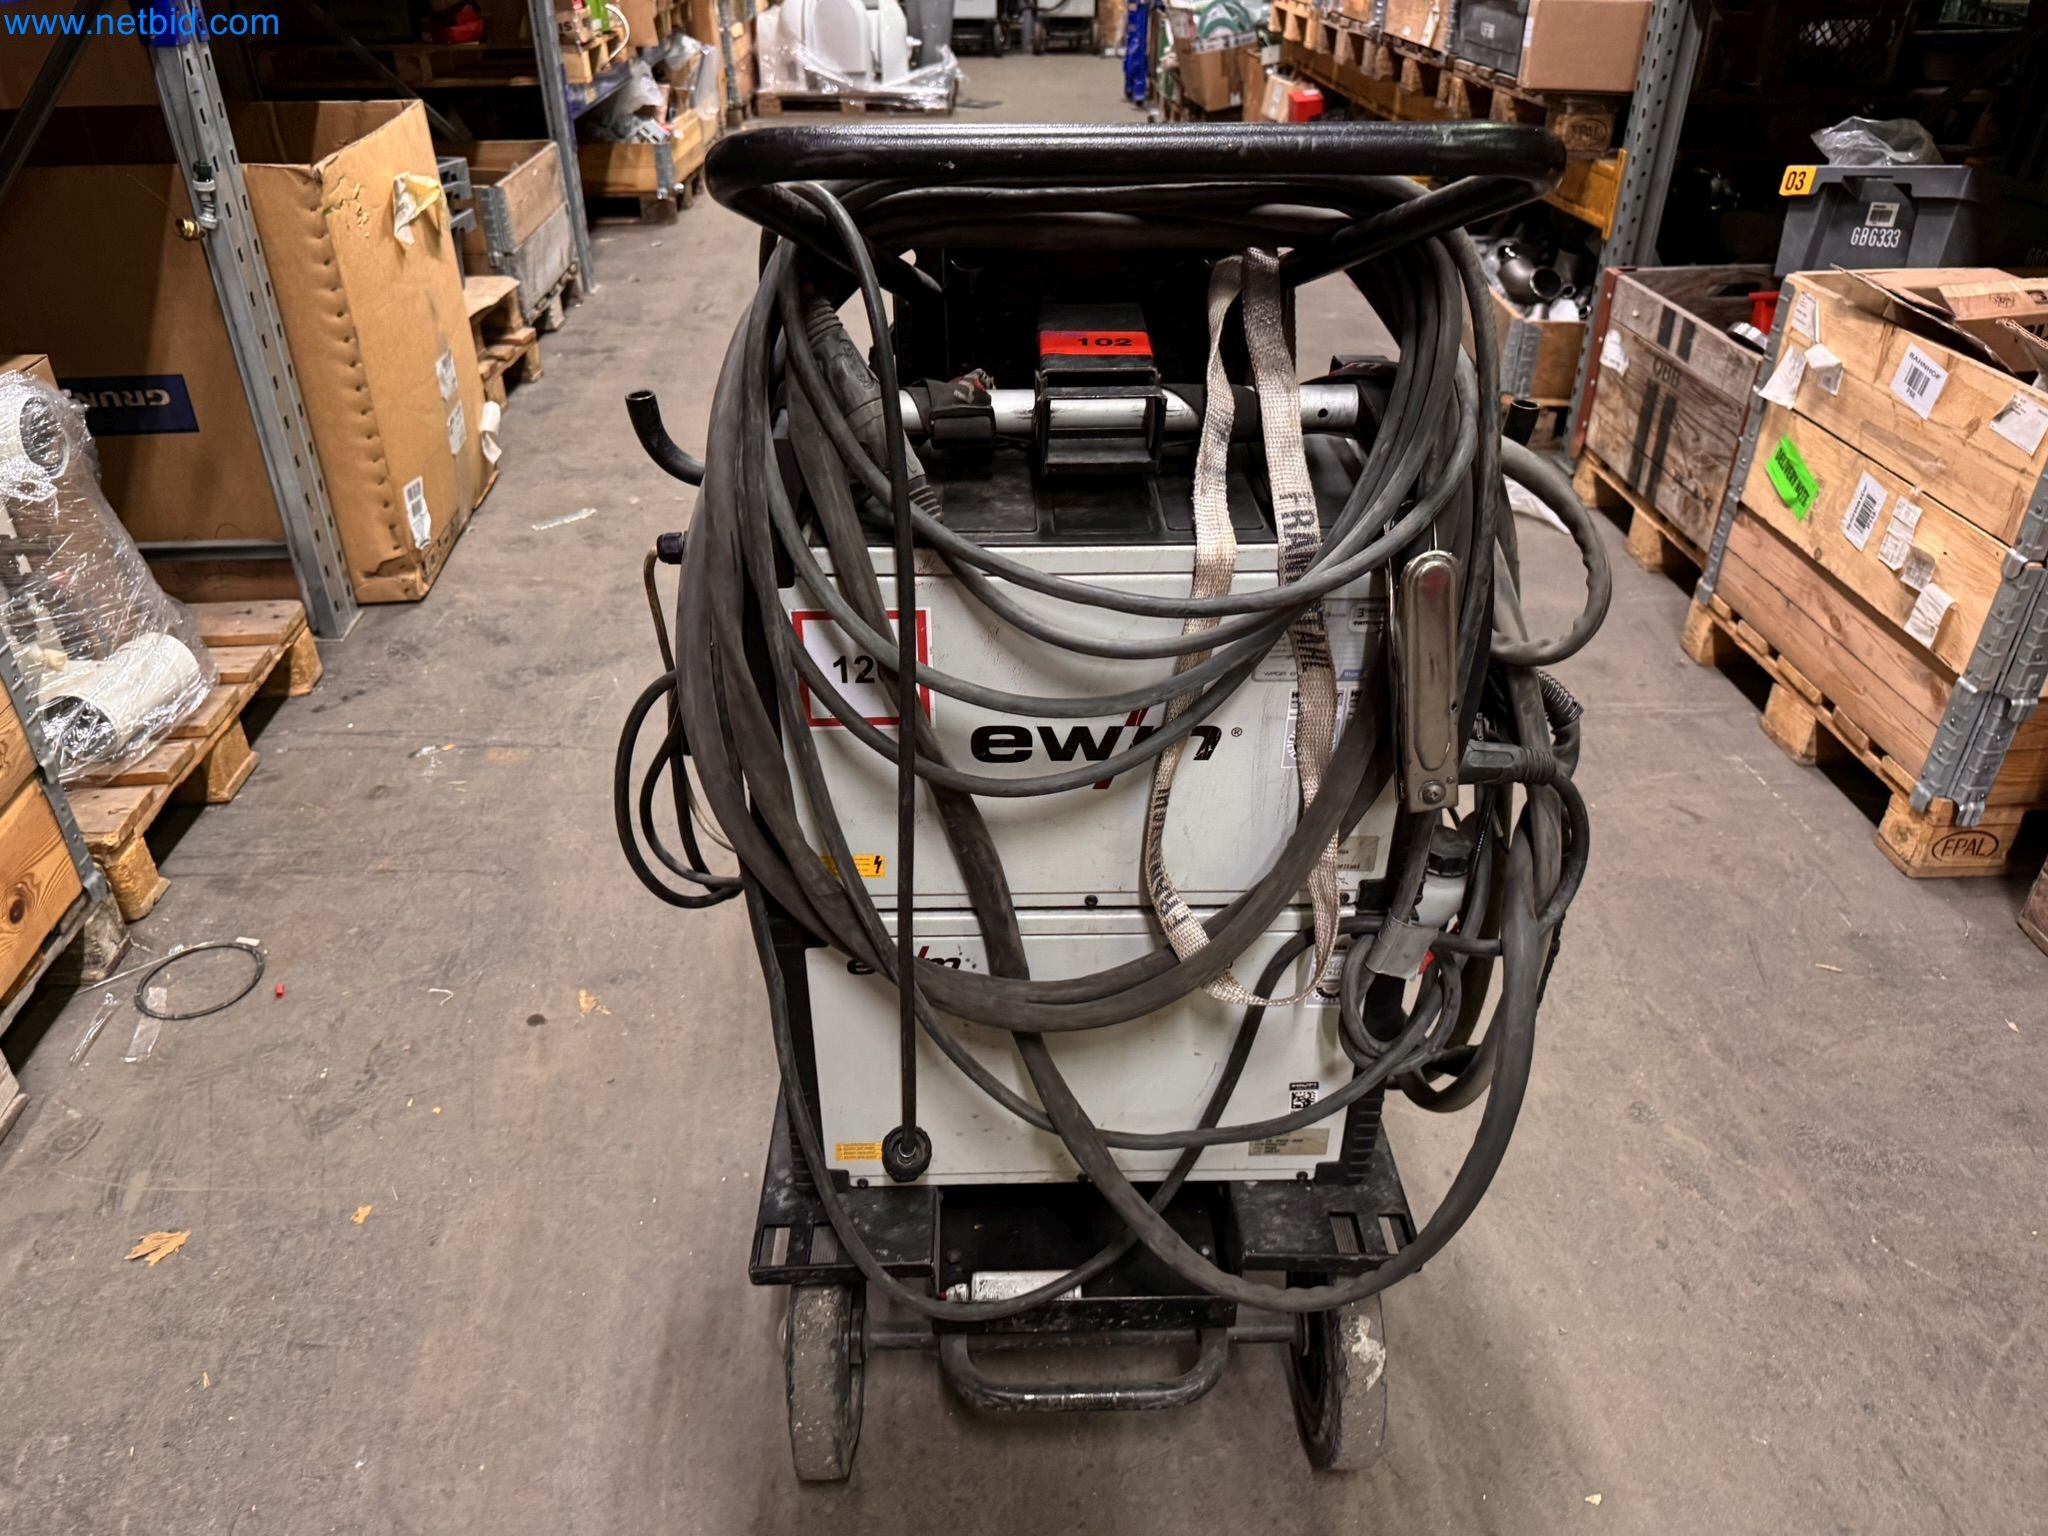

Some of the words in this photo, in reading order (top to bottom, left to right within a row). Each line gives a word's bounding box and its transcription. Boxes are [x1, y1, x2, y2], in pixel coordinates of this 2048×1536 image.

[1785, 171, 1807, 191] 03
[1850, 226, 1901, 248] GBG333
[1078, 337, 1133, 346] 102
[1909, 351, 1941, 380] BAHNHOF
[1793, 480, 1810, 507] NOTE
[833, 656, 883, 684] 12
[1940, 838, 1985, 857] EPAL
